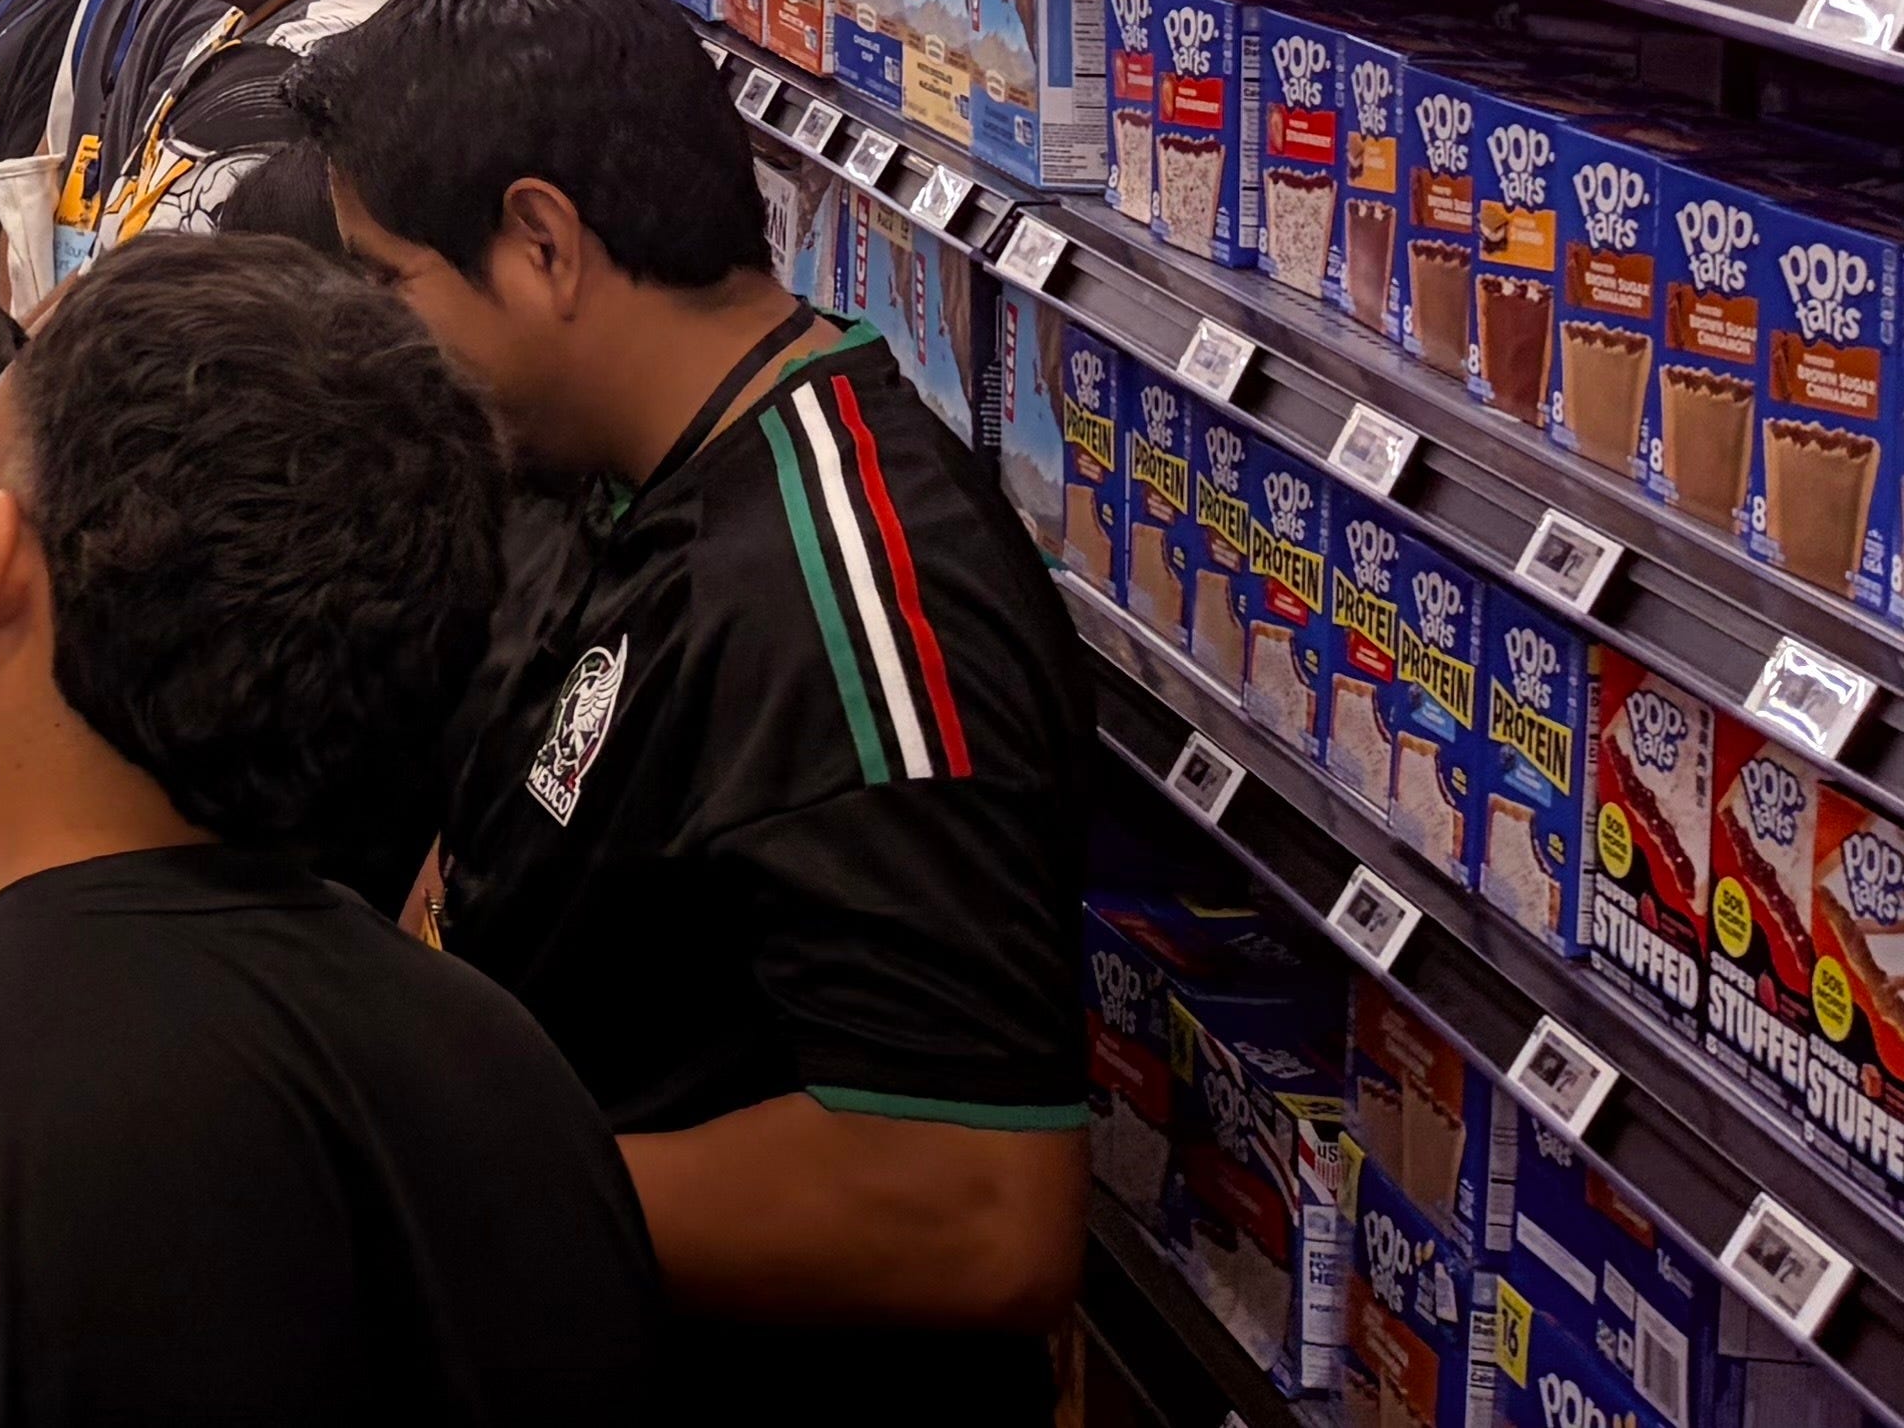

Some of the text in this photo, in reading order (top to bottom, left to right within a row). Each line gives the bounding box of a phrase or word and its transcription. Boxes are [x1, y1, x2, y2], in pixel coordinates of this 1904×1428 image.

[852, 194, 871, 308] CLIF
[1688, 248, 1748, 292] tarts
[1794, 296, 1862, 341] tarts
[1796, 359, 1878, 400] BROWN SUGAR
[1806, 380, 1867, 410] CINNAMON
[1753, 497, 1766, 526] 8
[1251, 524, 1322, 607] PROTEIN
[1401, 629, 1474, 719] PROTEIN
[528, 766, 573, 819] MEXICO
[1595, 872, 1637, 908] SUPER
[1593, 894, 1698, 1010] STUFFED
